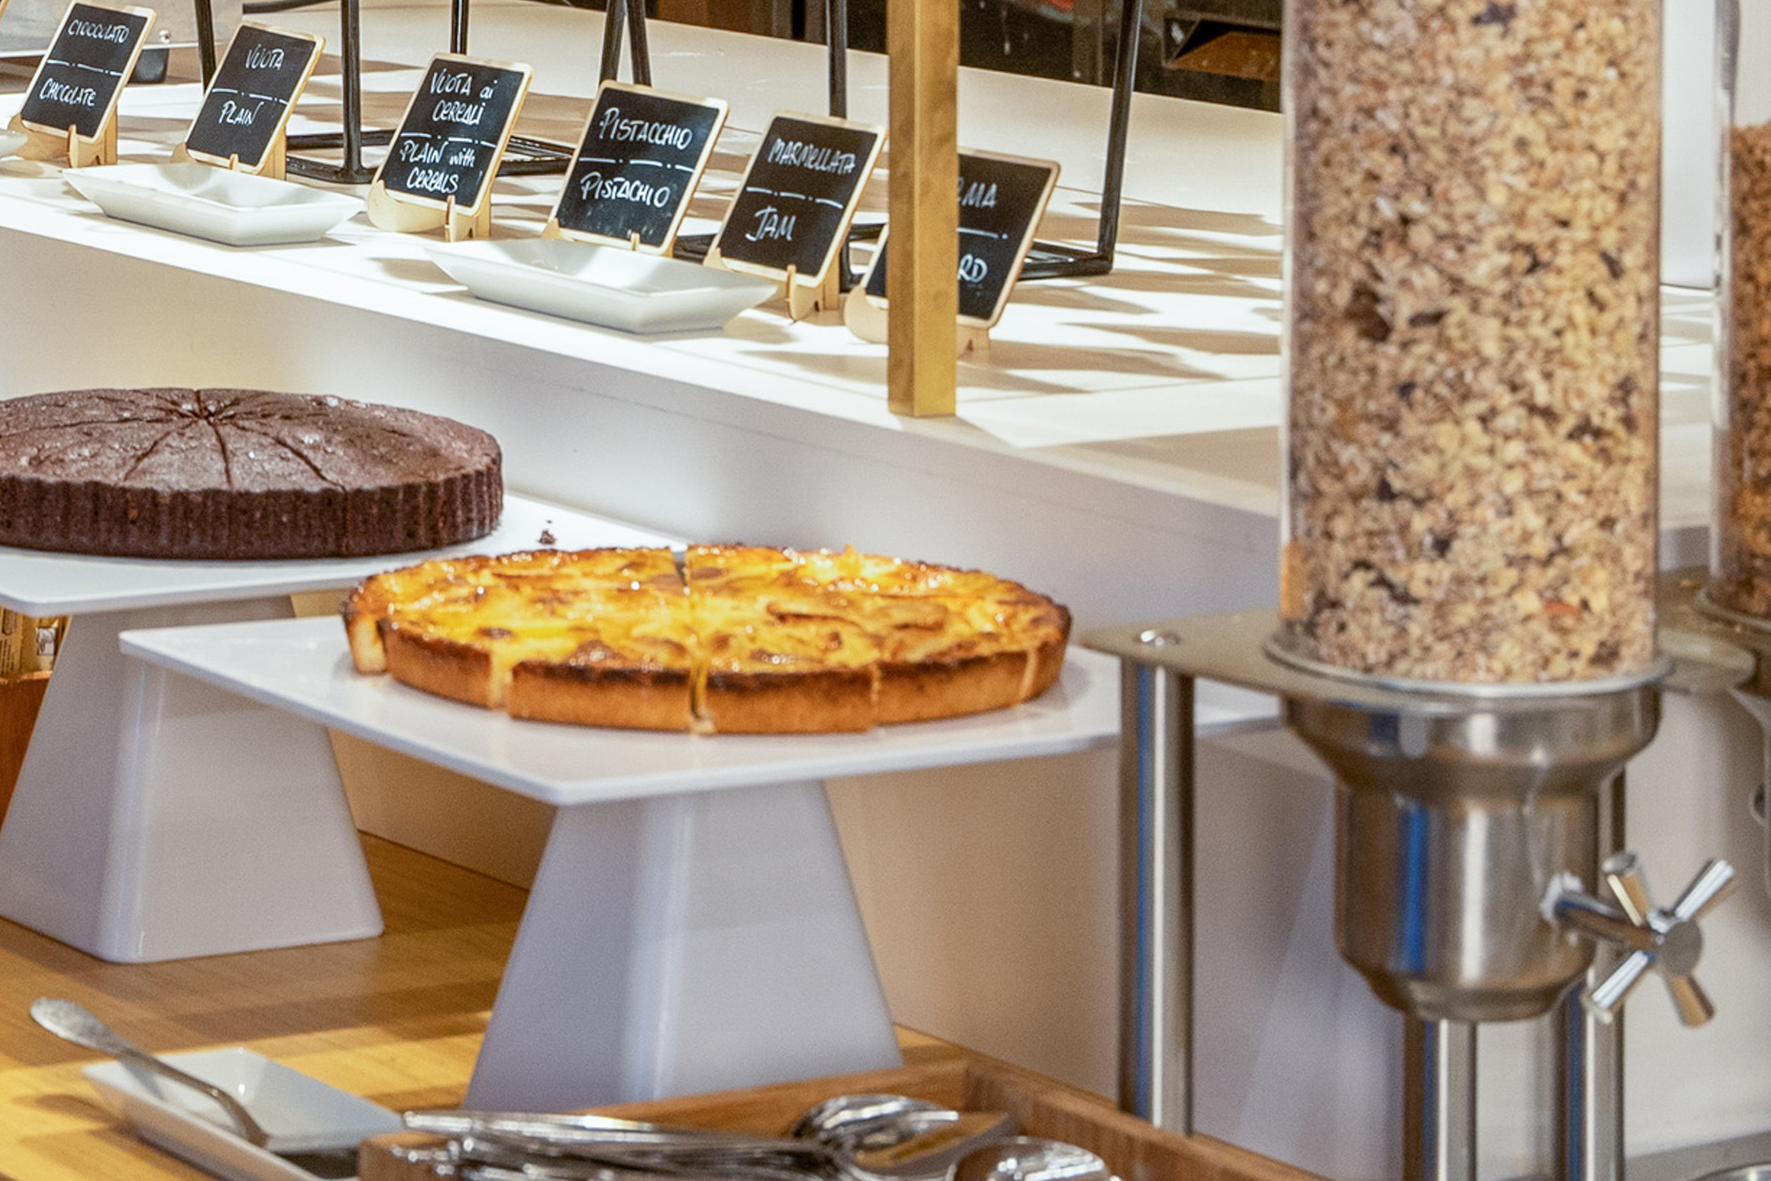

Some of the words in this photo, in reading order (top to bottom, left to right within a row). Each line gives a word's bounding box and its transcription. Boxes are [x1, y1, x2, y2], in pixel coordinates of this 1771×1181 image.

[67, 18, 130, 44] CIOCCOLATO
[245, 43, 285, 71] VUOTA
[38, 77, 97, 107] CHOCOLATE
[429, 68, 473, 97] VUOTA
[479, 79, 498, 99] ai
[218, 99, 265, 127] PLAIN
[598, 107, 693, 150] PISTACCHIO
[399, 139, 449, 164] PLAIN
[449, 147, 476, 168] with
[767, 138, 856, 174] MARMELLATA
[406, 166, 459, 194] CEREALS
[579, 171, 671, 208] PISTACHIO
[958, 177, 998, 208] MA
[745, 205, 797, 241] JAM
[957, 253, 988, 283] RD
